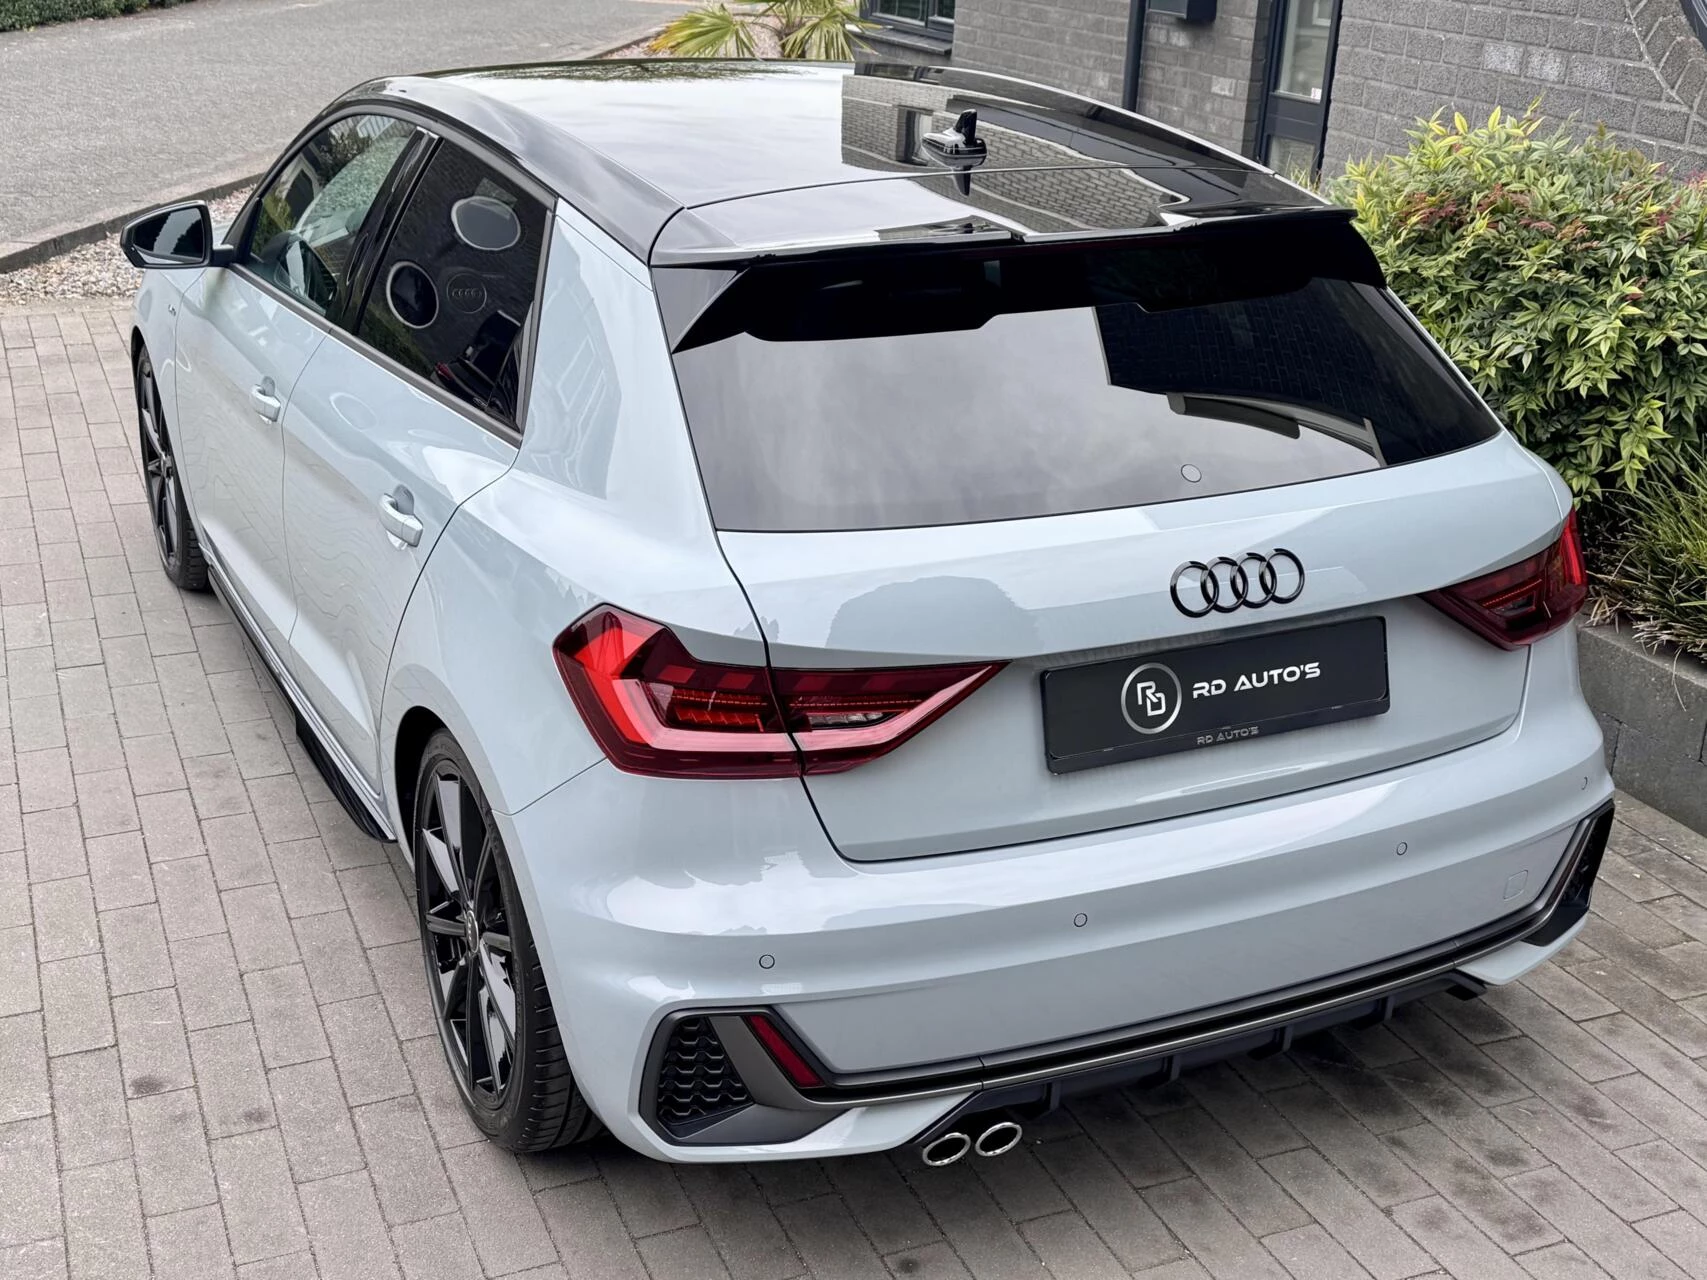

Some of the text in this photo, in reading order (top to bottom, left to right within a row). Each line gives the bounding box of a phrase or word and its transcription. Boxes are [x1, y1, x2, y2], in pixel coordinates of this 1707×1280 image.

[1136, 680, 1167, 717] RD
[1192, 661, 1321, 699] RD AUTO'S
[1196, 725, 1259, 745] RD AUTO'S
